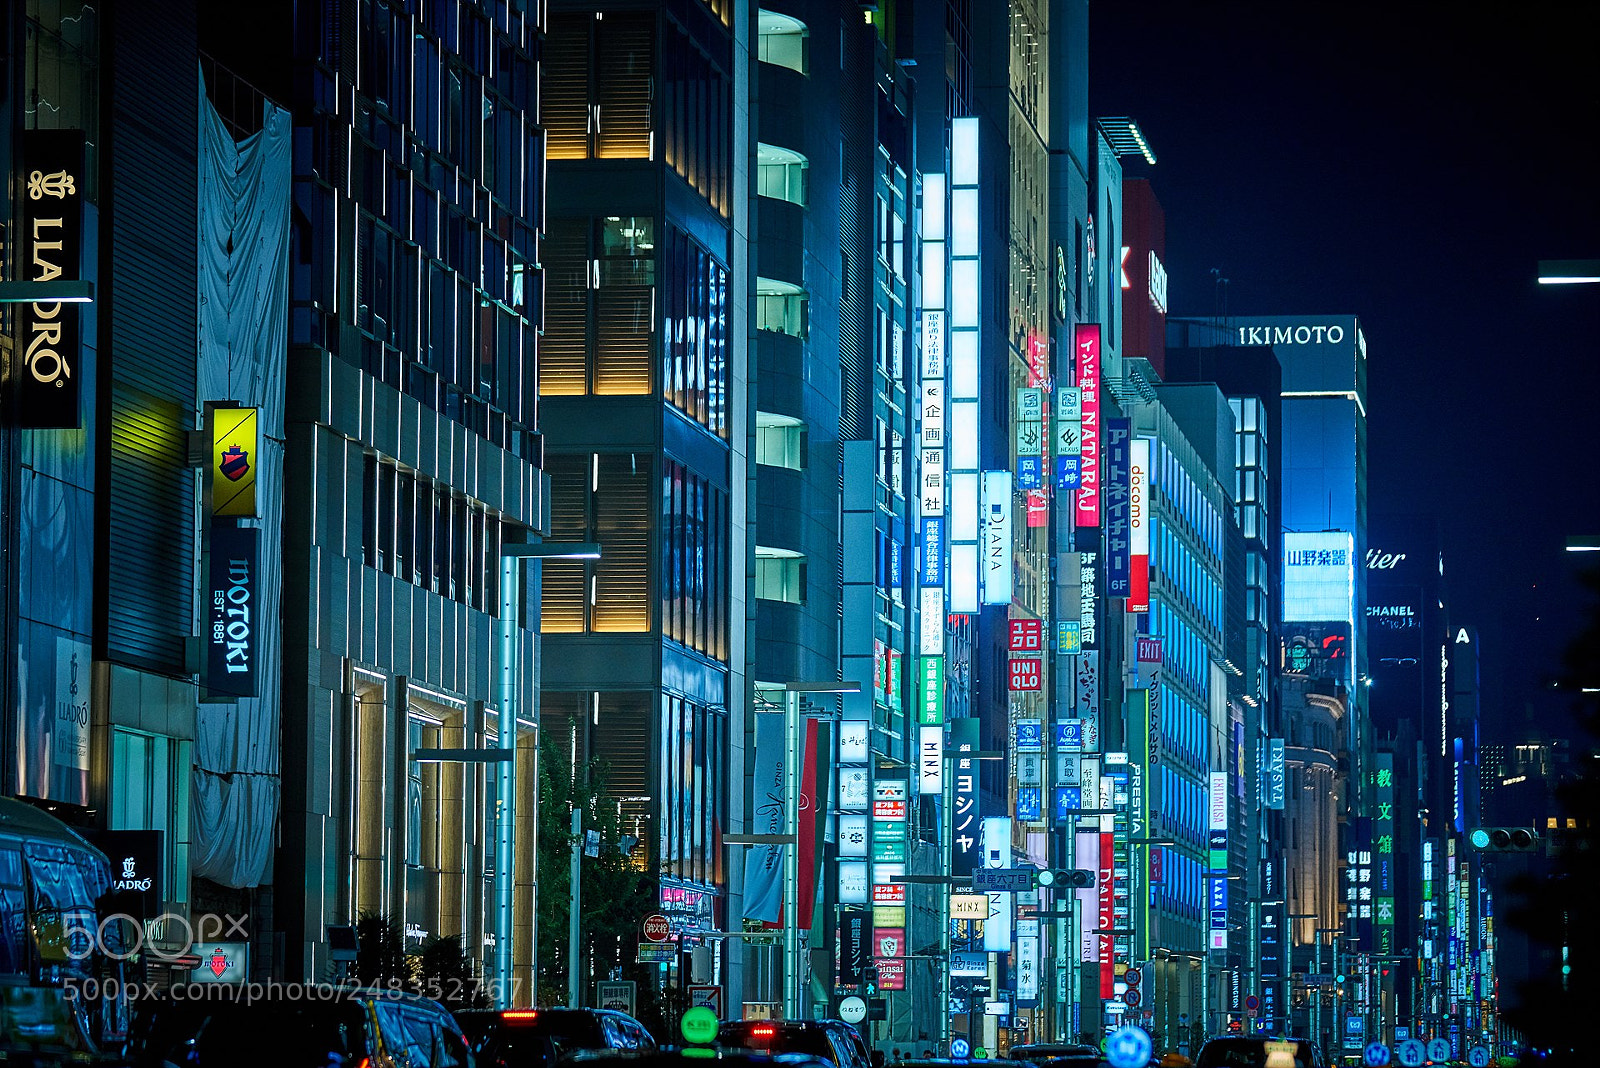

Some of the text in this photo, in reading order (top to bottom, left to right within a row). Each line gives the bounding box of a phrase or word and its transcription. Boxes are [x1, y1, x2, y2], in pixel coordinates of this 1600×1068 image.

[1080, 339, 1096, 403] インド料理
[925, 404, 941, 511] 企画通信社
[1079, 411, 1096, 513] NATARAJ
[1108, 428, 1128, 570] アートネイチャー
[1131, 465, 1144, 528] docomo
[1287, 549, 1347, 567] 山野楽器
[1111, 579, 1127, 590] 6F
[213, 589, 225, 644] EST 1881
[1013, 622, 1038, 634] ユニ
[1012, 636, 1038, 648] クロ
[1139, 642, 1160, 660] EXIT
[1083, 651, 1092, 659] 5F
[1012, 662, 1036, 674] UNI
[926, 658, 937, 723] 西銀座診療所
[1012, 675, 1038, 689] QLO
[924, 742, 939, 778] MINX
[1064, 757, 1074, 777] 買取
[774, 761, 783, 788] GINZA
[1272, 746, 1283, 803] TASAKI
[955, 743, 974, 853] 銀座ヨシノヤ
[976, 874, 1028, 885] 銀座六丁目
[1358, 851, 1372, 919] 山野楽器
[957, 902, 980, 912] MINX
[1377, 901, 1392, 920] 本
[646, 922, 668, 934] 消火栓
[851, 917, 861, 977] 銀座ヨシノヤ
[1127, 973, 1138, 982] 50
